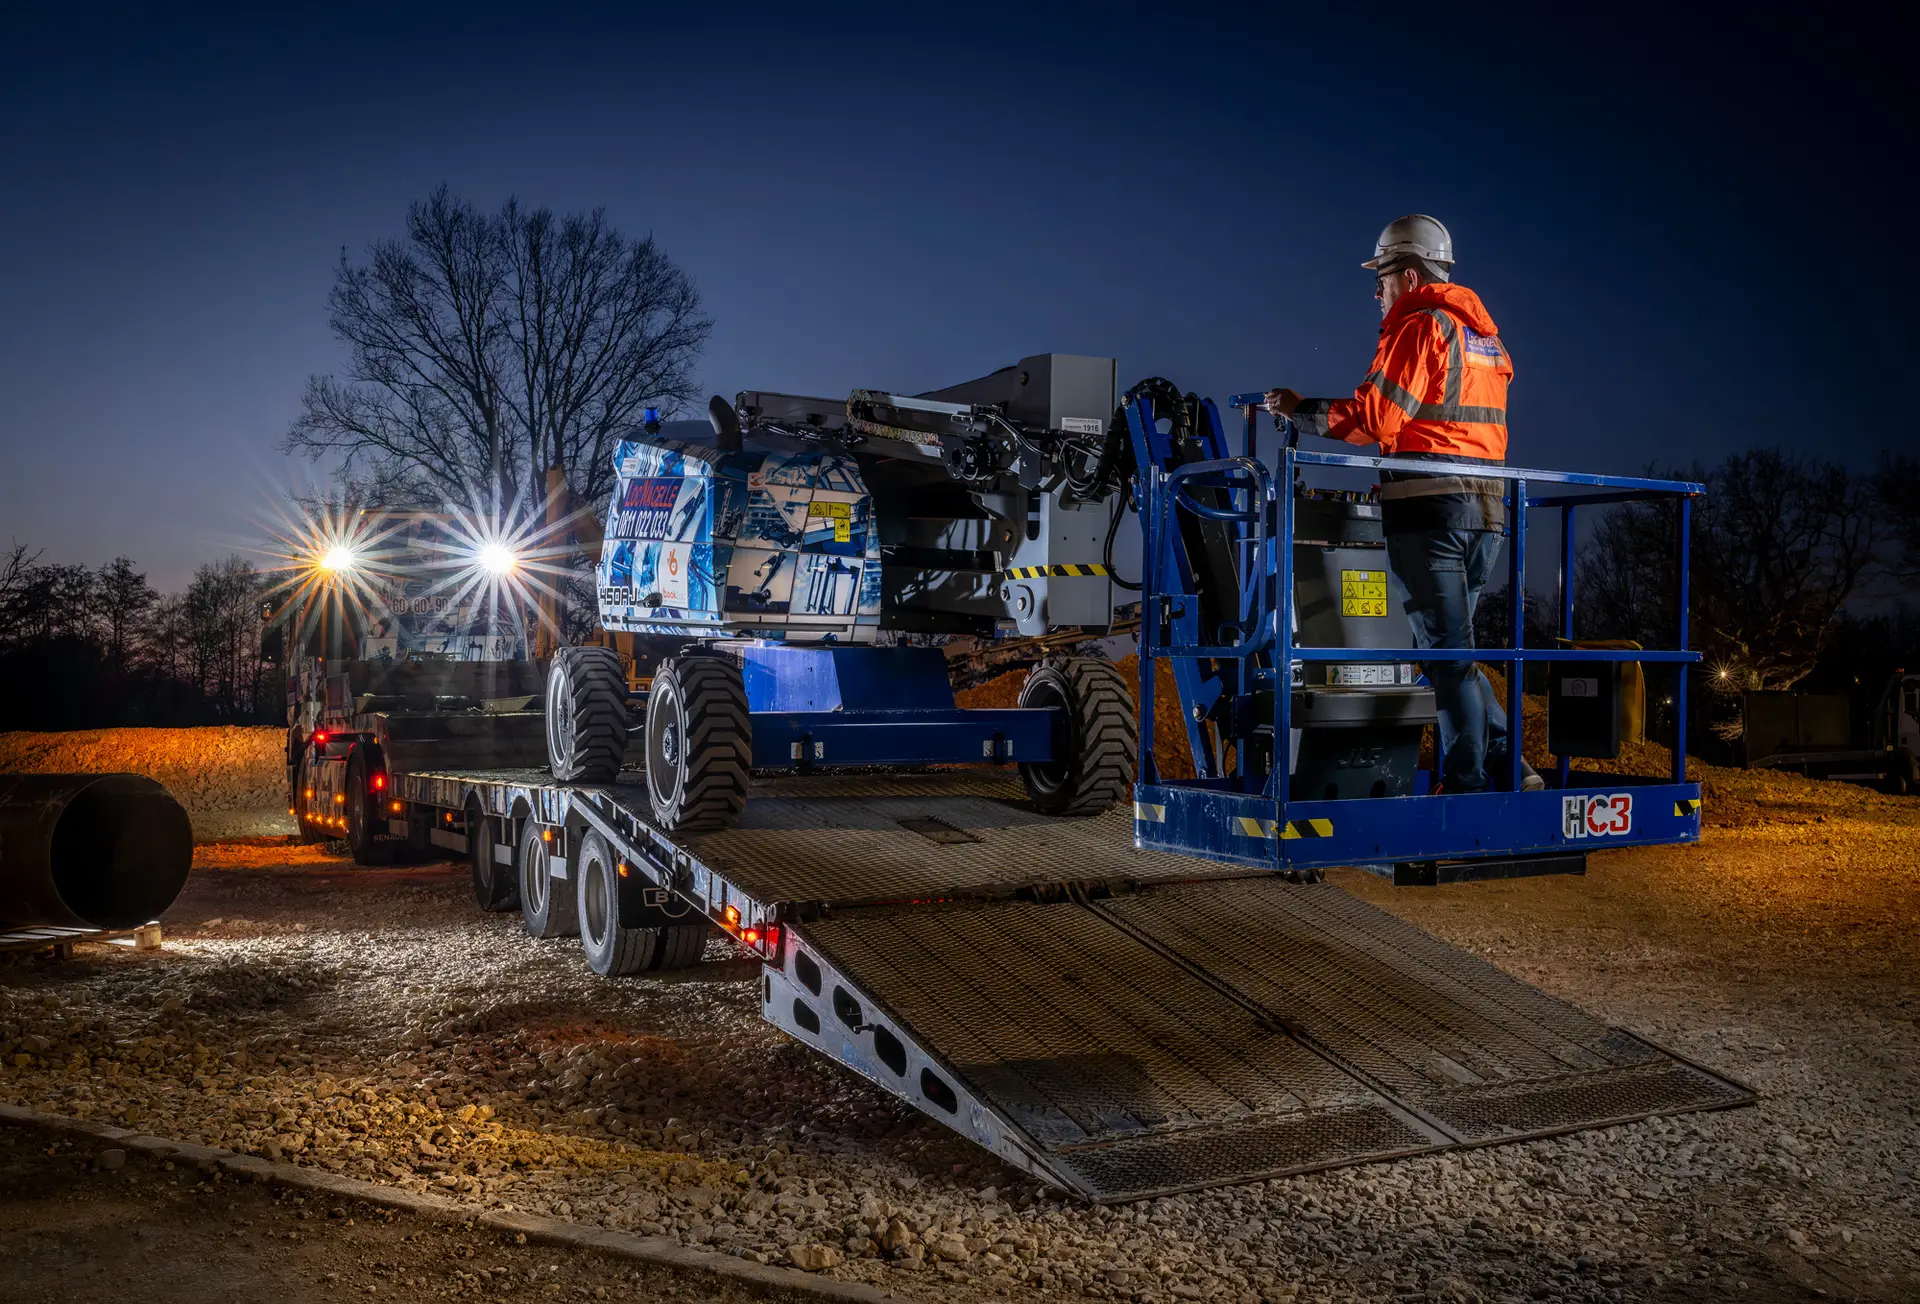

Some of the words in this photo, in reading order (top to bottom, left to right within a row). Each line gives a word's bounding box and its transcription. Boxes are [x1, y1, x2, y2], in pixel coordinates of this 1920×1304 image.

[1083, 424, 1100, 432] 1916
[617, 510, 637, 537] 0811
[634, 510, 653, 538] 022
[650, 510, 669, 539] 033
[392, 599, 406, 613] 60
[414, 599, 427, 613] 80
[435, 598, 448, 613] 90
[1563, 794, 1632, 838] HC3
